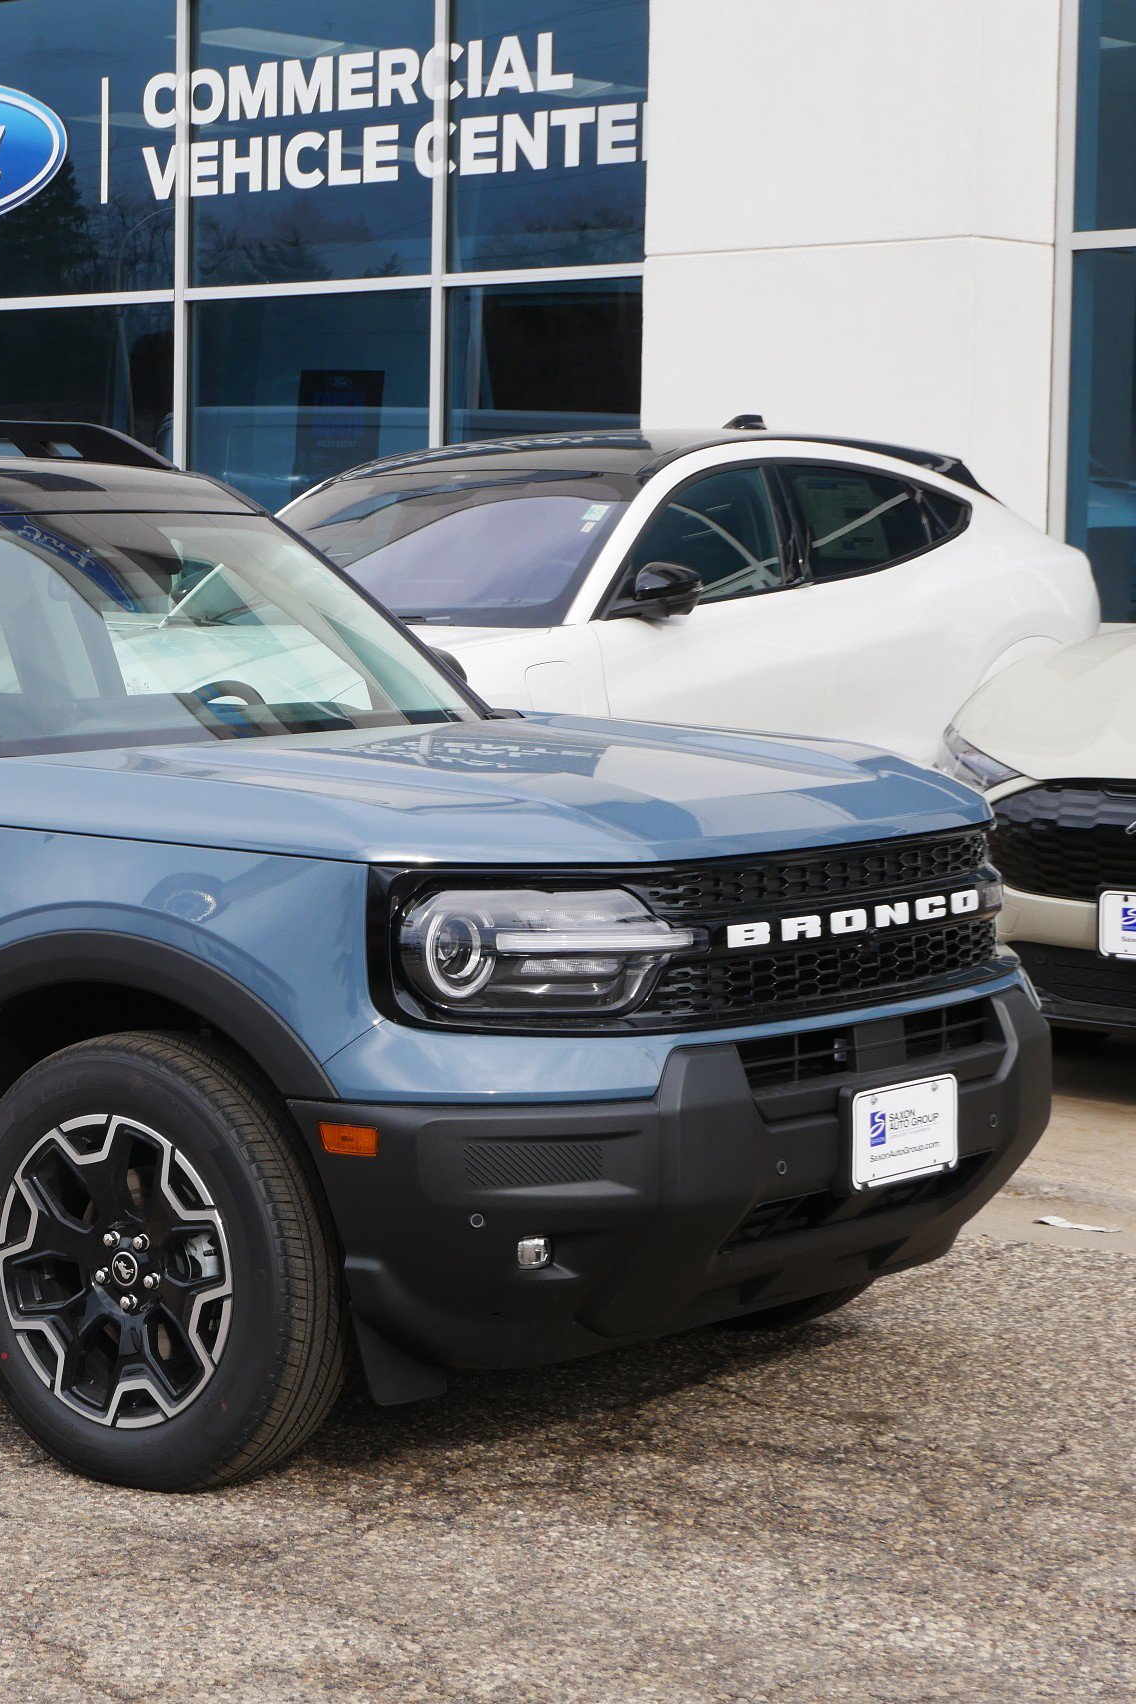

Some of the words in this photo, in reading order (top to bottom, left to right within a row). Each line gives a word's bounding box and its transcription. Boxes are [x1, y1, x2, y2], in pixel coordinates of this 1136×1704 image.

[142, 32, 574, 129] COMMERCIAL
[142, 124, 400, 201] VEHICLE
[414, 101, 648, 179] CENTE
[727, 889, 979, 949] BRONCO
[889, 1109, 916, 1122] SAXON
[889, 1118, 909, 1131] AUTO
[911, 1112, 939, 1126] GROUP
